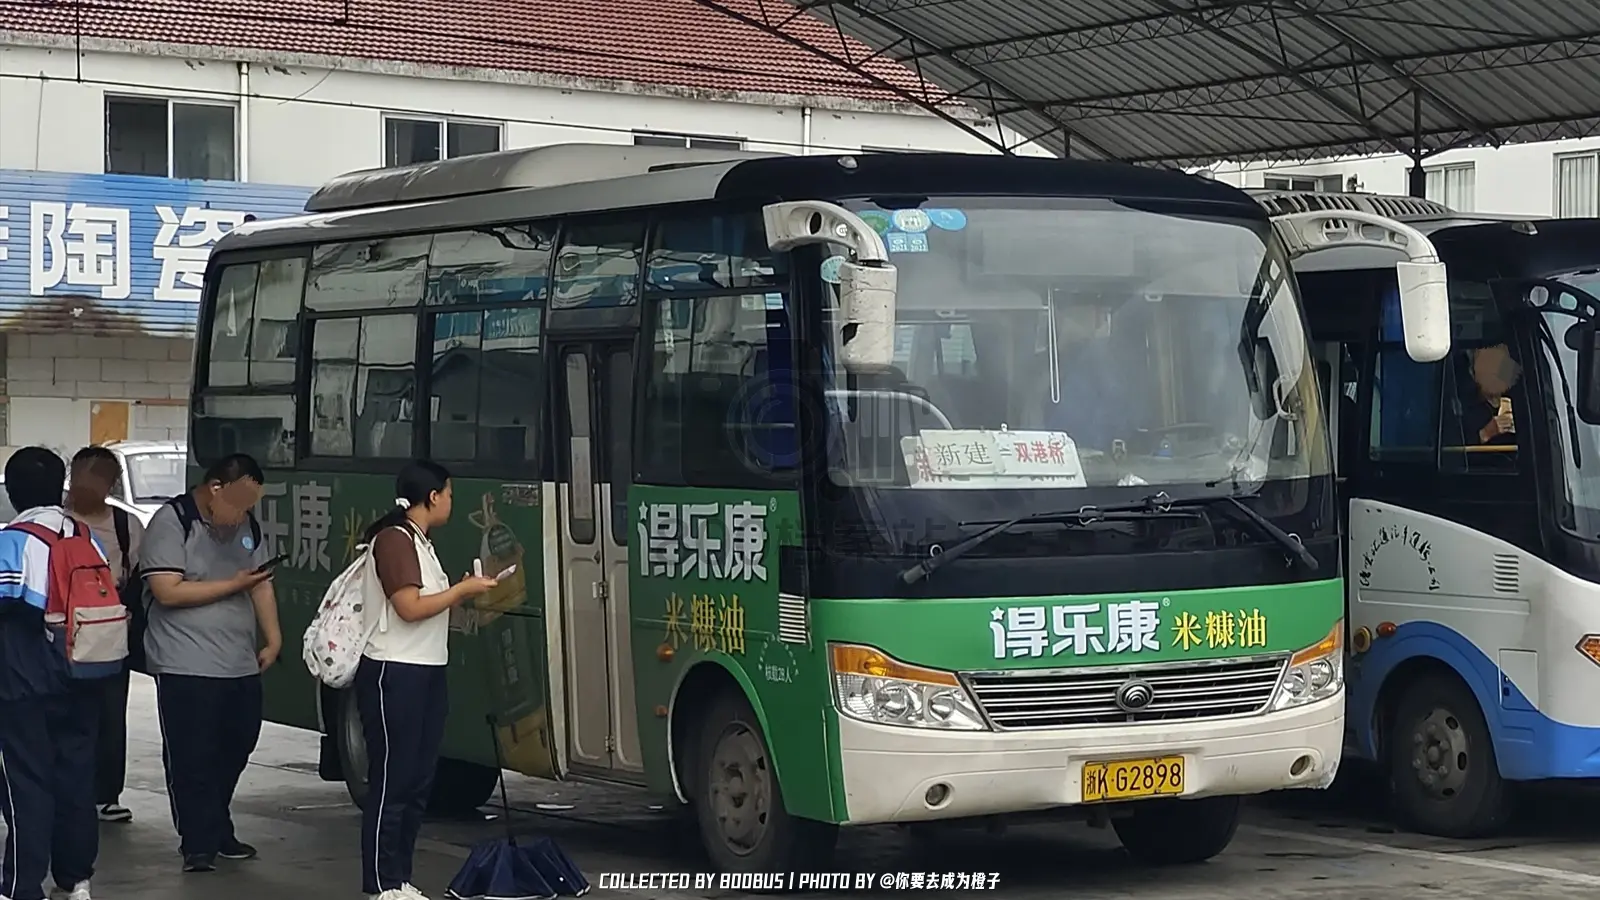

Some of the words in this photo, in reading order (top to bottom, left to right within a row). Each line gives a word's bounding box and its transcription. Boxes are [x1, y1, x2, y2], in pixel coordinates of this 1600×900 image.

[0, 200, 245, 302] 陶瓷
[934, 441, 993, 466] 新建
[1013, 440, 1066, 465] 双港桥
[637, 500, 768, 582] 得乐康
[663, 592, 746, 654] 米糠油
[989, 600, 1160, 659] 得乐康
[1171, 608, 1268, 651] 米糠油
